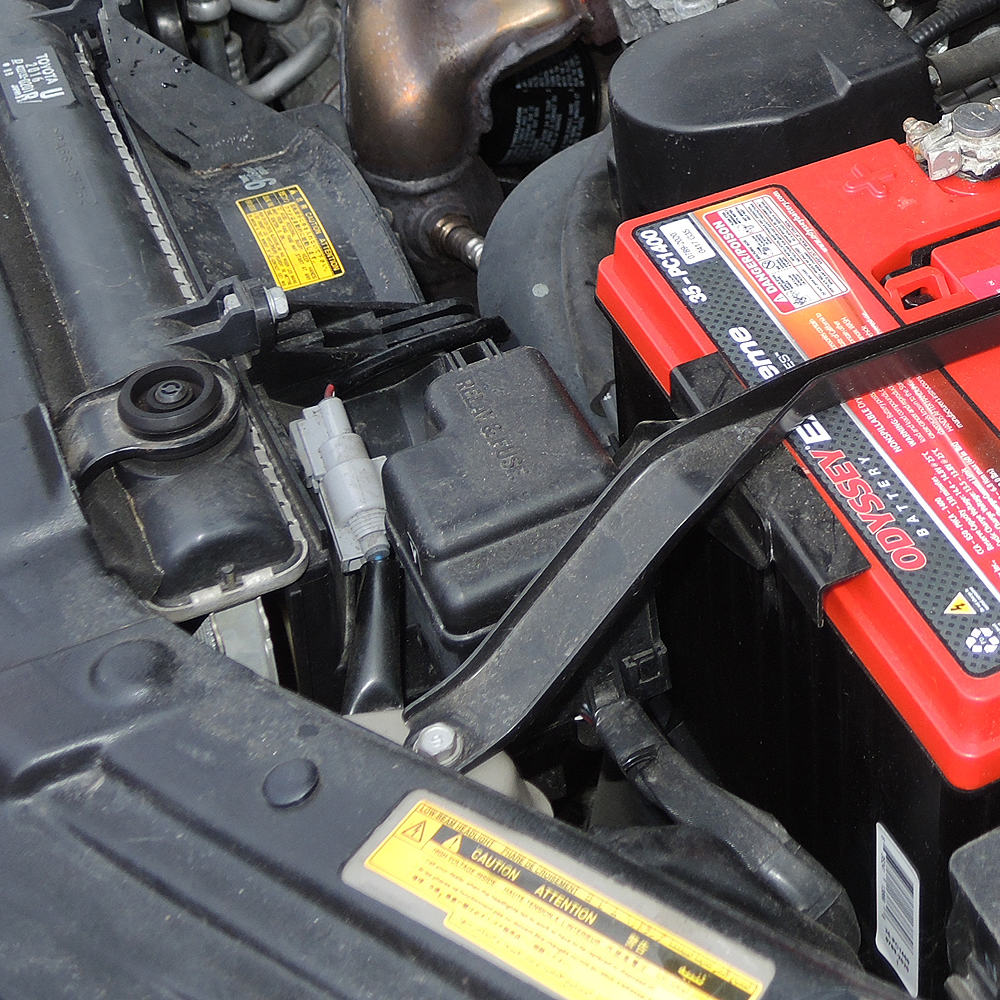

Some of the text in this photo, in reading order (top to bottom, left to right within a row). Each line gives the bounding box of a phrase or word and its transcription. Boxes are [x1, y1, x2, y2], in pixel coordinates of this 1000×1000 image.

[36, 53, 59, 85] TOYOTA
[317, 236, 341, 272] ATTENTION
[710, 219, 779, 294] DANGER/POISON
[885, 383, 909, 406] reproduct
[860, 406, 903, 453] NONSPILLABLE
[888, 416, 918, 447] WARNING:
[959, 466, 976, 482] Limit
[969, 462, 984, 476] max
[978, 473, 991, 484] Nm
[856, 455, 931, 536] BATTERY
[948, 483, 963, 496] 14.4
[969, 478, 991, 499] Current
[932, 495, 949, 510] 1400
[956, 493, 981, 516] Voltage:
[966, 489, 991, 512] Voltage:
[928, 475, 995, 551] Reserve Capacity 130 minutes
[973, 512, 995, 533] Charge
[959, 528, 974, 541] 850
[971, 542, 986, 555] CCA
[469, 845, 522, 883] CAUTION
[523, 860, 535, 871] DE
[532, 880, 599, 927] ATTENTION
